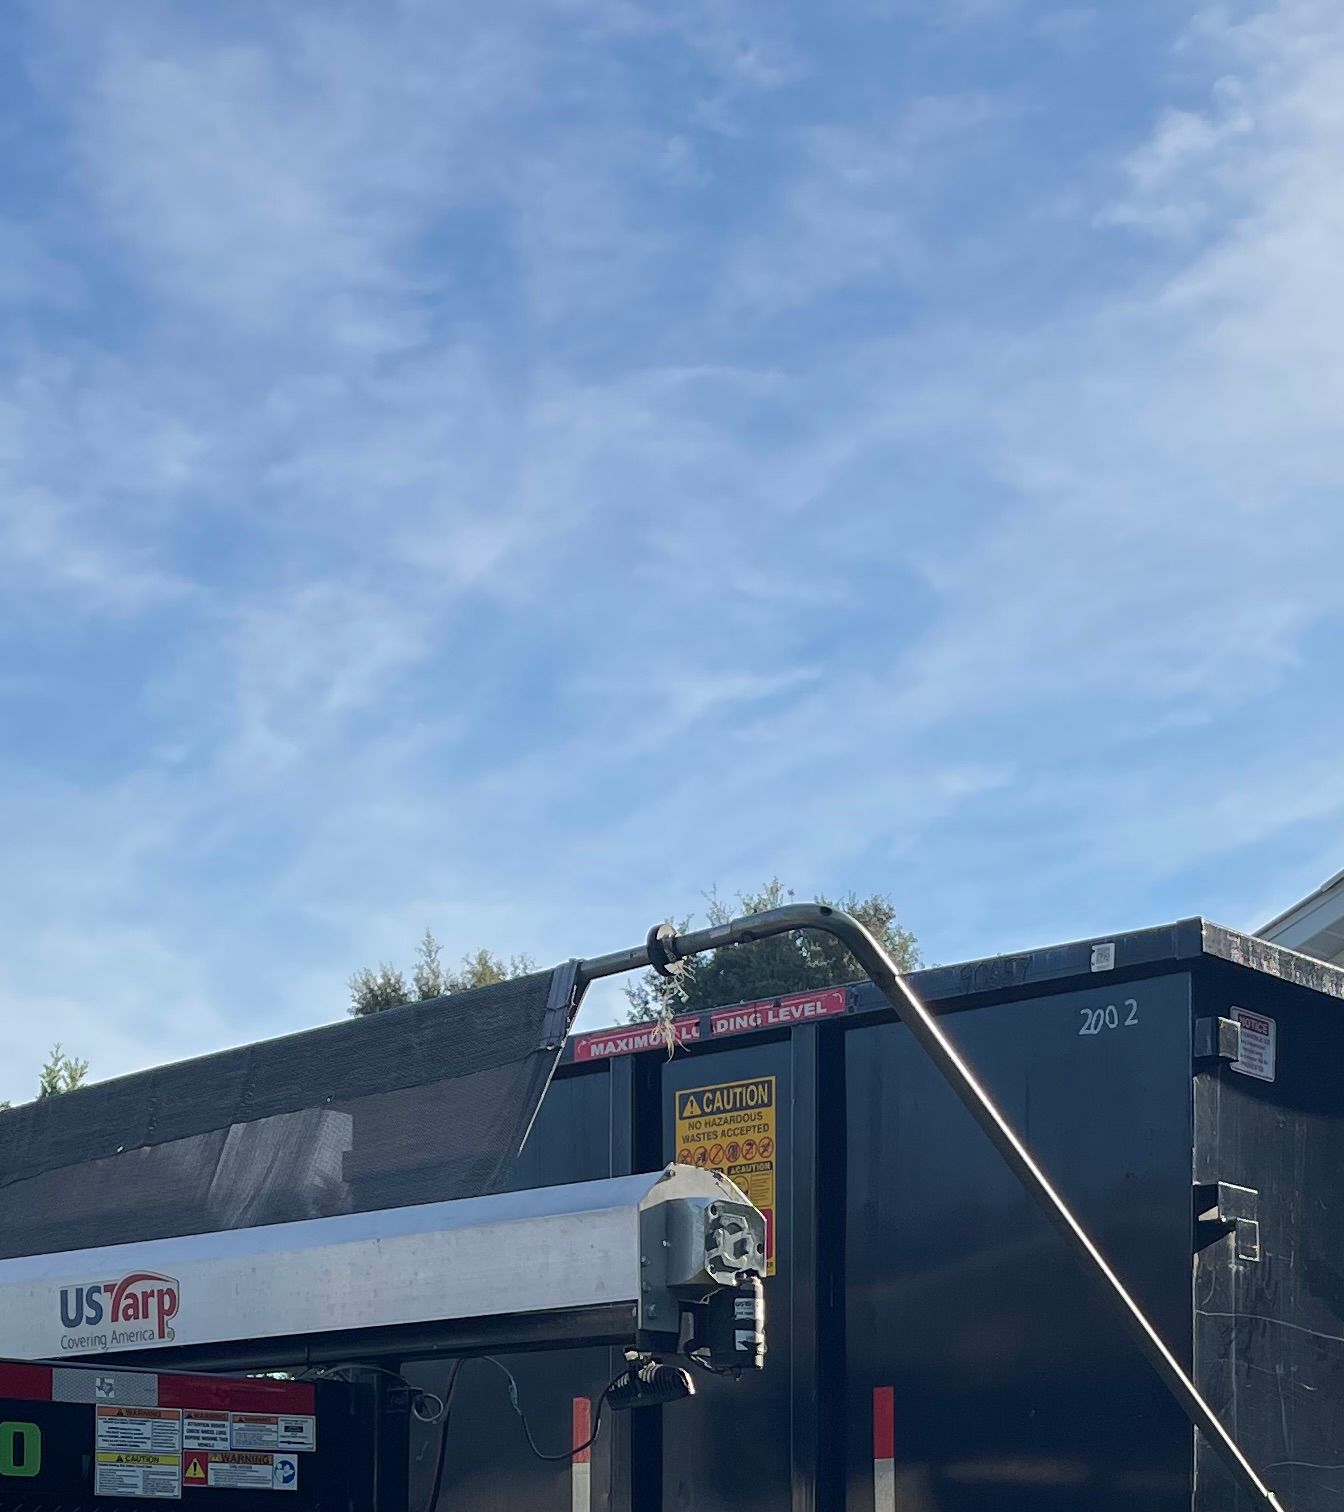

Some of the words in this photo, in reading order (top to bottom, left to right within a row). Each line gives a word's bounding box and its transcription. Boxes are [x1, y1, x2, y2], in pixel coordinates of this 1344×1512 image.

[1078, 998, 1139, 1036] 2002
[590, 1032, 675, 1057] MAXIMU
[681, 1013, 762, 1040] LODING
[767, 1001, 827, 1024] LEVEL
[702, 1083, 768, 1113] CAUTION
[687, 1120, 702, 1131] NO
[704, 1111, 763, 1129] HAZARDOUS
[682, 1130, 718, 1144] WASTES
[720, 1123, 770, 1138] ACCEPTED
[735, 1162, 771, 1174] CAUTION
[60, 1334, 108, 1350] Covering
[110, 1329, 155, 1344] America
[124, 1455, 160, 1464] CAUTION
[220, 1453, 272, 1465] WARNING
